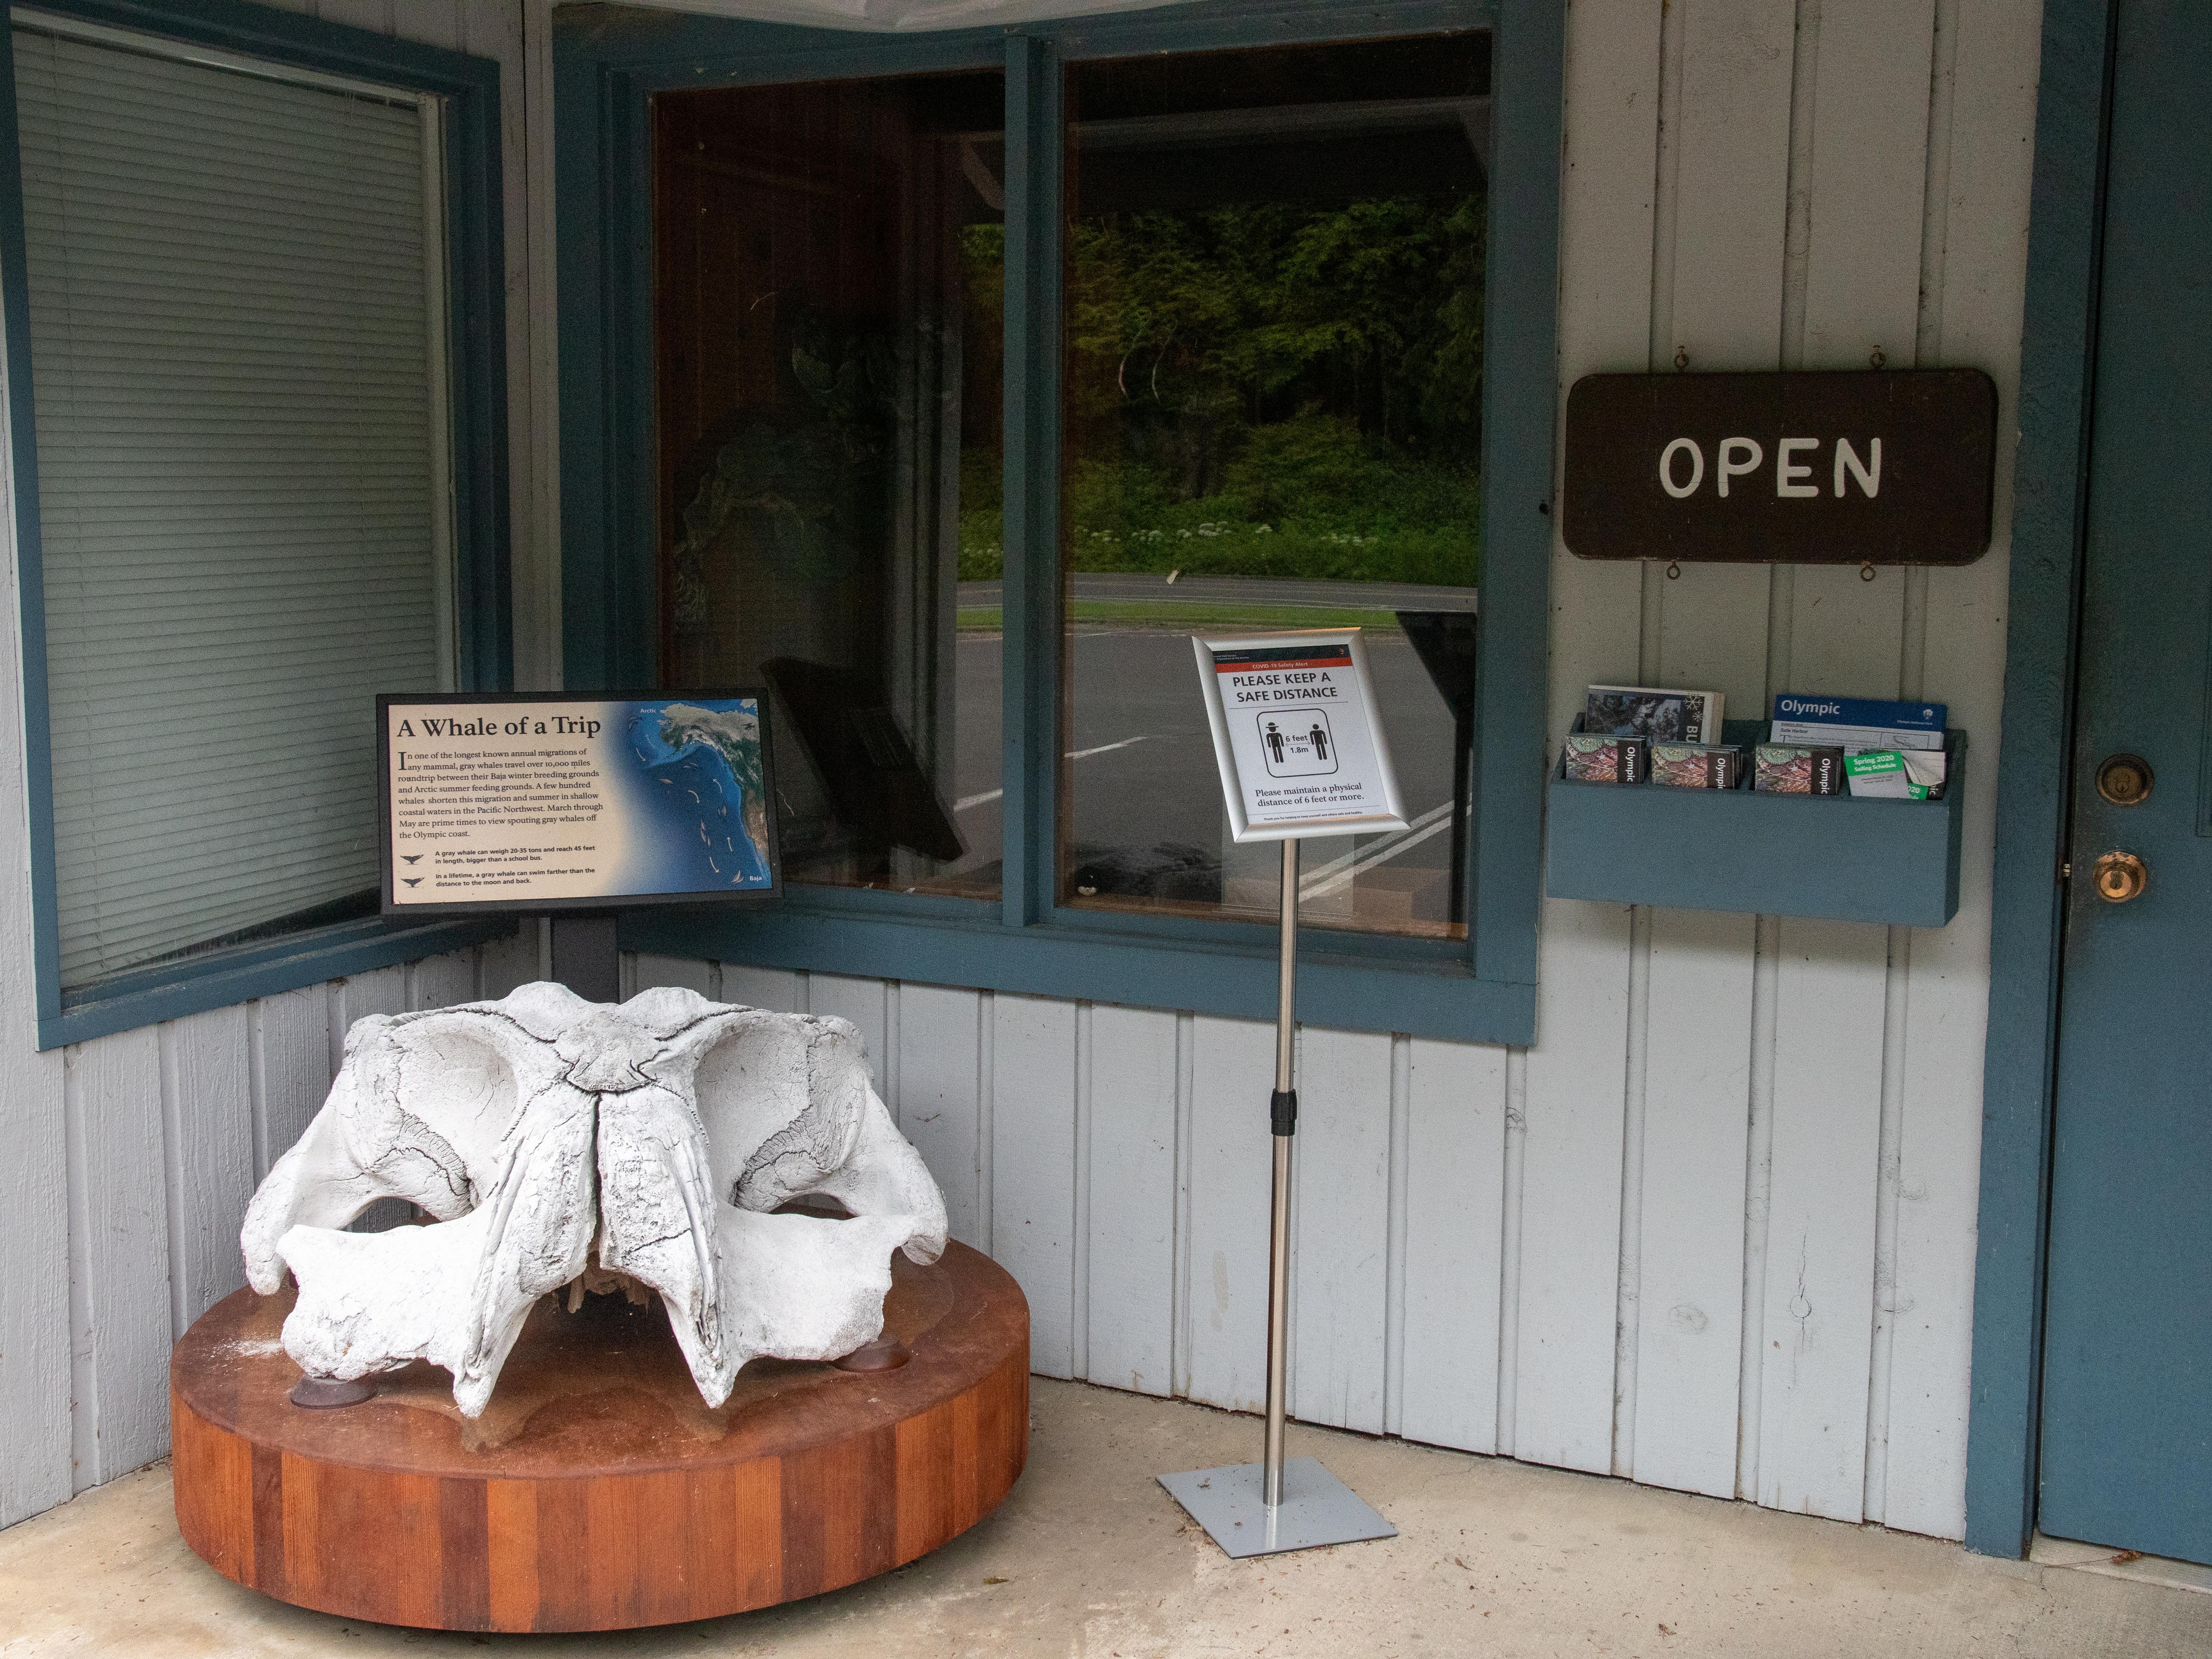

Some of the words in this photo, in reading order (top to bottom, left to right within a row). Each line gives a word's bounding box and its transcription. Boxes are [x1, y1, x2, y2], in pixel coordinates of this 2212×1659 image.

[1659, 437, 1882, 499] OPEN
[1232, 674, 1281, 687] PLEASE
[1284, 672, 1316, 684] KEEP
[1321, 672, 1331, 682] A
[1237, 690, 1269, 702] SAFE
[1273, 687, 1338, 700] DISTANCE
[1781, 699, 1840, 716] Olympic
[396, 719, 416, 737] A
[420, 717, 497, 736] Whale
[504, 716, 529, 735] of
[534, 722, 547, 734] a
[551, 716, 601, 738] Trip
[398, 751, 413, 771] In
[454, 751, 481, 760] longest
[538, 749, 577, 758] migrations
[1625, 747, 1636, 782] Olympic
[1853, 757, 1876, 765] Spring
[398, 774, 435, 783] roundtrip
[490, 772, 506, 781] Baja
[533, 771, 568, 779] breeding
[568, 770, 600, 779] grounds
[1819, 758, 1831, 794] Olympic
[472, 784, 500, 792] feeding
[501, 783, 534, 792] grounds.
[1283, 786, 1320, 795] maintain
[1329, 782, 1362, 794] physical
[474, 795, 511, 804] migration
[1294, 796, 1302, 804] of
[573, 803, 603, 812] through
[399, 820, 416, 829] May
[431, 819, 454, 828] prime
[507, 816, 541, 826] spouting
[413, 831, 446, 840] Olympic
